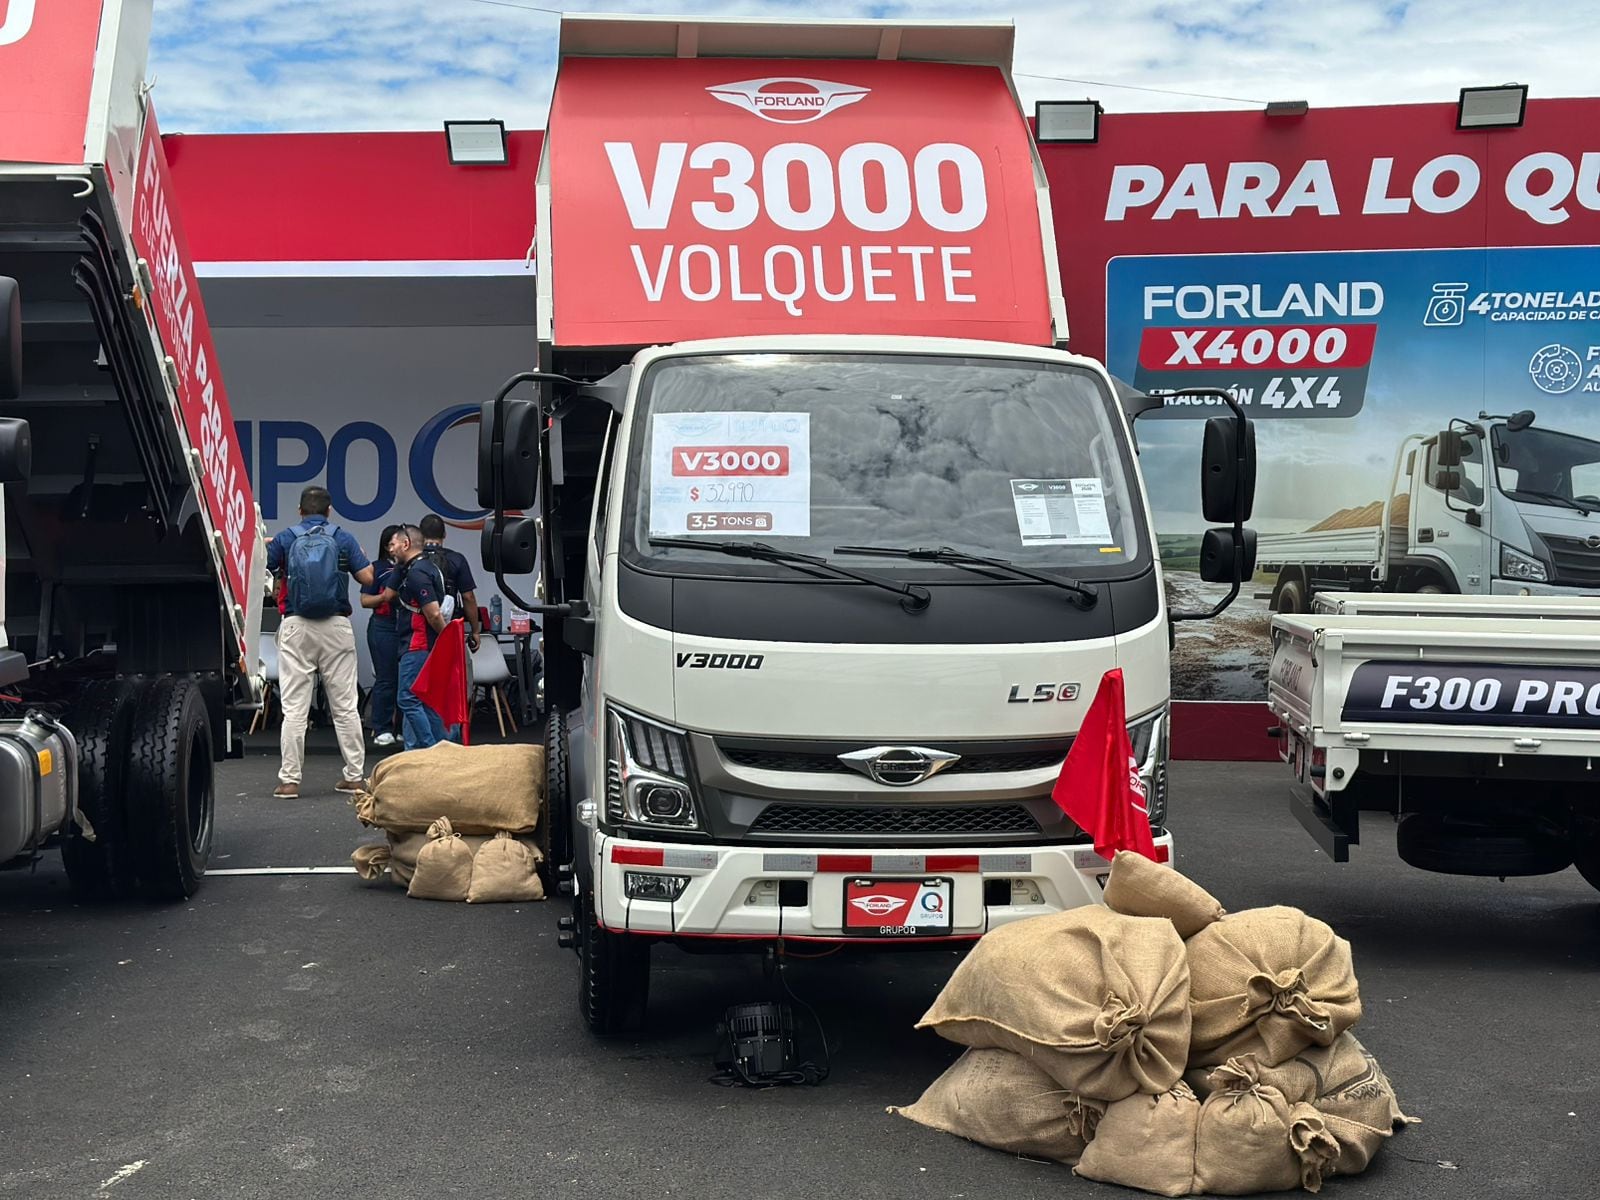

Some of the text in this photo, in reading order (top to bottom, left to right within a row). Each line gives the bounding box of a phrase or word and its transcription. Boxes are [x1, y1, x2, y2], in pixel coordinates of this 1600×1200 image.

[754, 96, 825, 107] FORLAND
[603, 141, 988, 232] V3000
[1104, 159, 1340, 222] PARA
[1362, 154, 1481, 215] LO
[143, 136, 193, 365] FUERZA
[630, 244, 976, 316] VOLQUETE
[1144, 281, 1384, 320] FORLAND
[1490, 310, 1565, 322] CAPACIDAD
[1569, 310, 1587, 321] DE
[1163, 327, 1347, 367] X4000
[1260, 376, 1341, 409] 4X4
[195, 343, 246, 533] PARA LO
[680, 451, 781, 471] V3000
[200, 412, 246, 596] QUE SEA
[690, 486, 700, 502] $
[691, 515, 753, 529] 3,5 TONS
[676, 652, 765, 669] V3000
[1380, 675, 1502, 712] F300
[921, 891, 944, 912] Q
